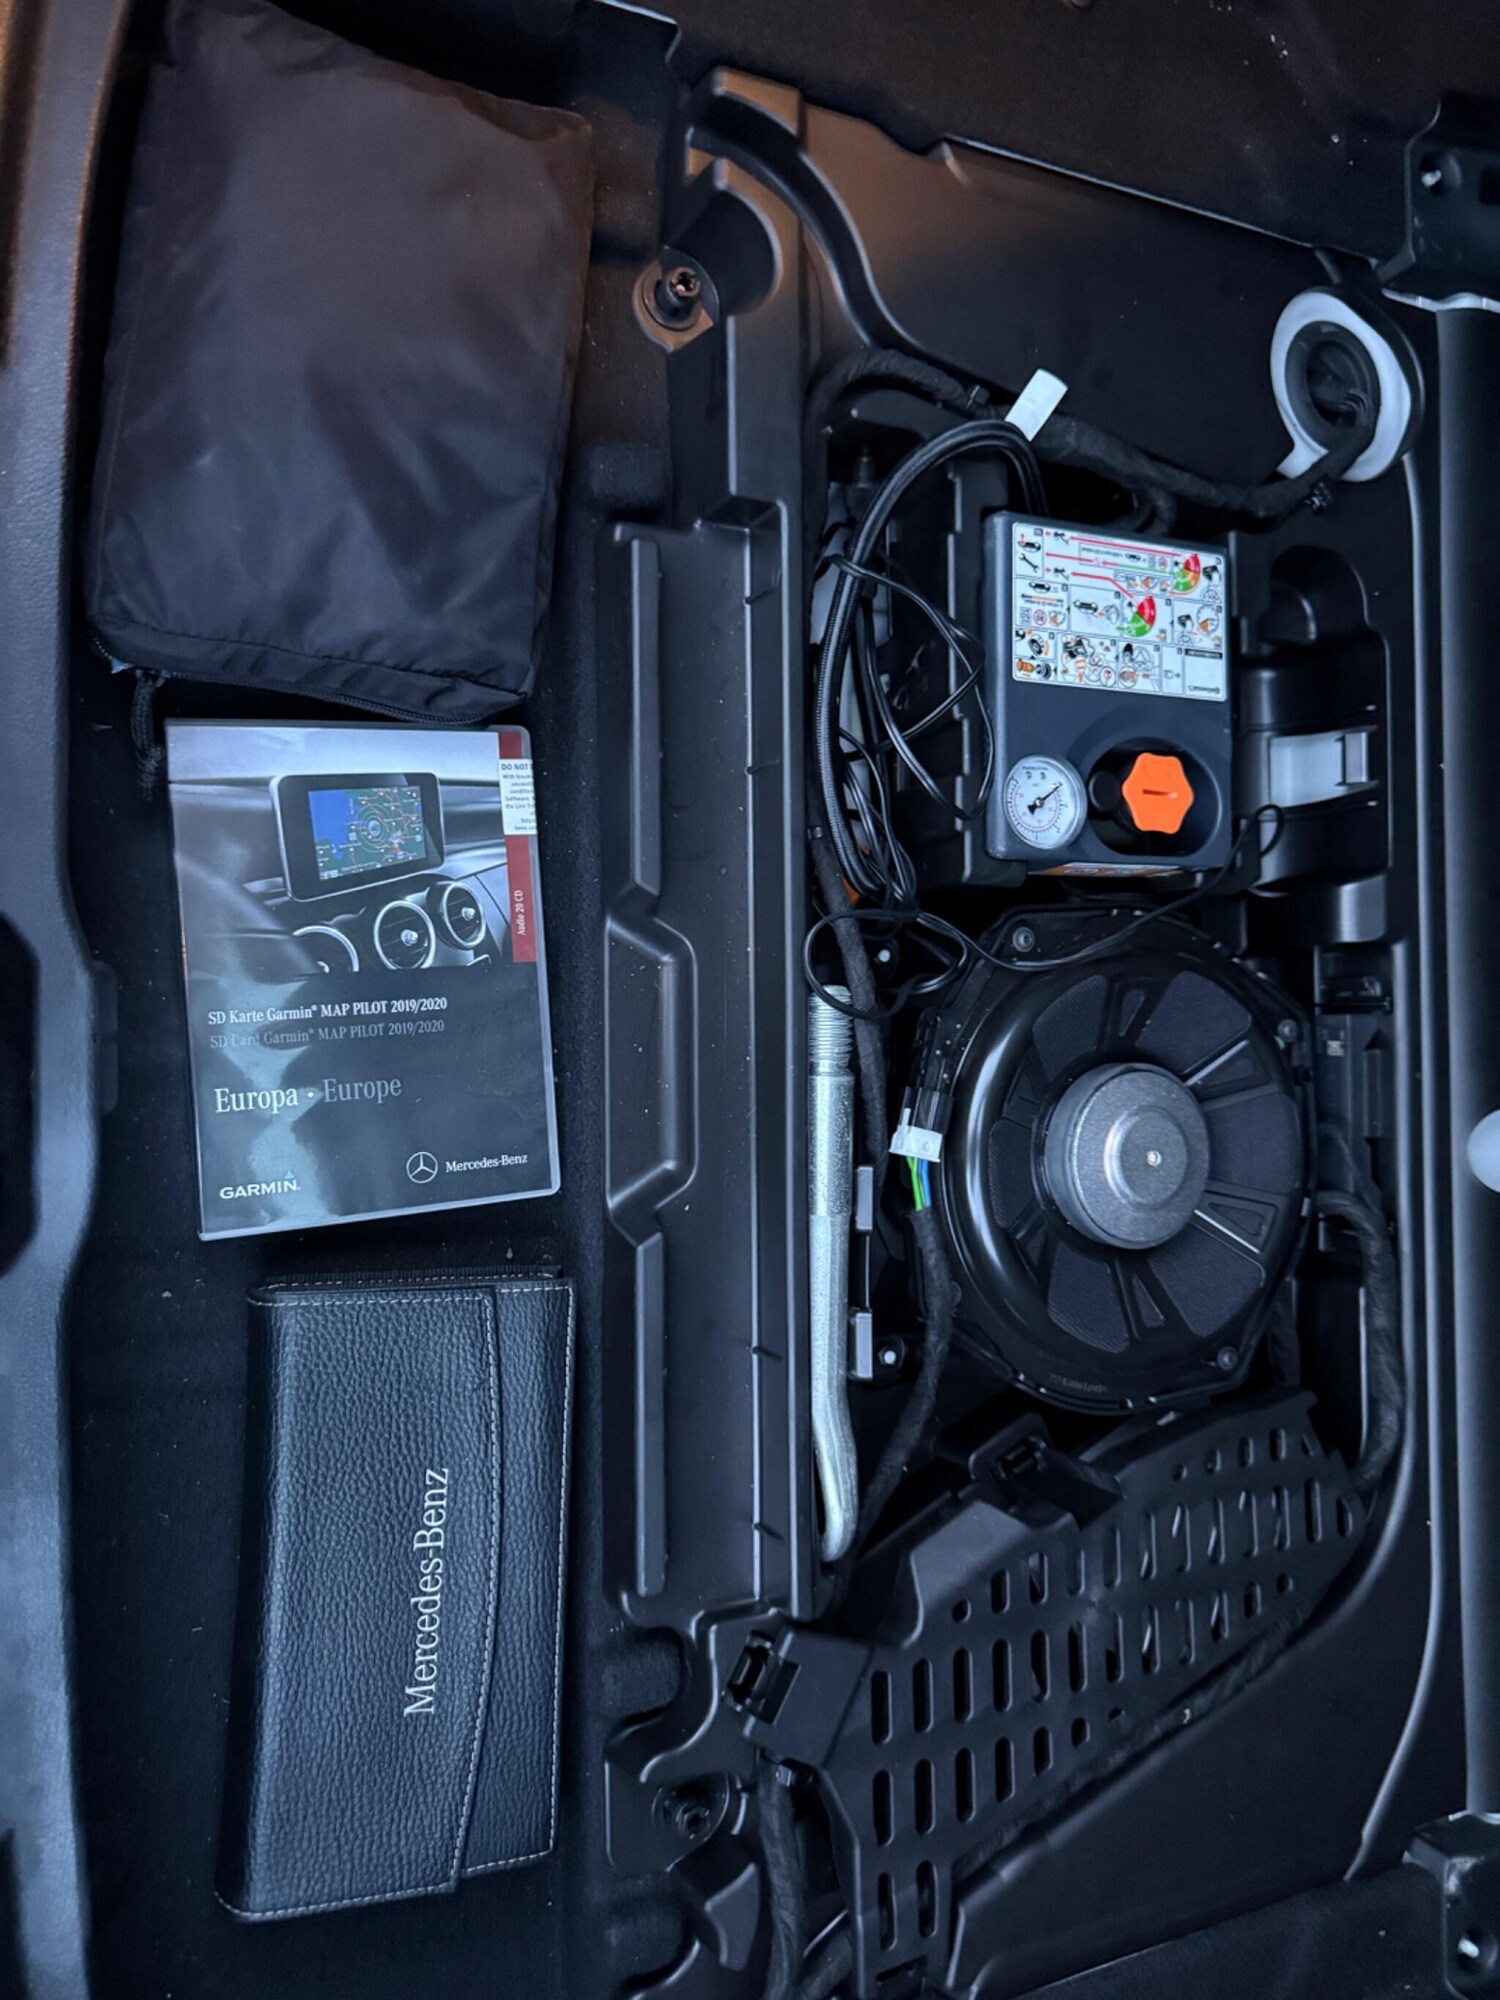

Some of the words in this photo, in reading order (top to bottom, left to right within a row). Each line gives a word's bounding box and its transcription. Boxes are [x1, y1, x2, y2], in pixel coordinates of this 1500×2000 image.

[513, 889, 524, 902] CD
[514, 902, 525, 913] 20
[515, 913, 527, 936] Audio
[208, 1010, 226, 1025] SD
[229, 1009, 264, 1024] Karte
[321, 1003, 350, 1018] MAP
[353, 1000, 387, 1016] PILOT
[390, 997, 448, 1014] 2019/2020
[210, 1034, 228, 1049] SD
[230, 1033, 260, 1048] Card
[318, 1027, 347, 1041] MAP
[350, 1023, 385, 1039] PILOT
[388, 1019, 445, 1037] 2019/2020
[213, 1088, 299, 1114] Europa
[322, 1078, 402, 1104] Europe
[445, 1153, 528, 1173] Mercedes-Benz
[219, 1178, 300, 1200] GARMIN
[403, 1468, 449, 1717] Mercedes-Benz
